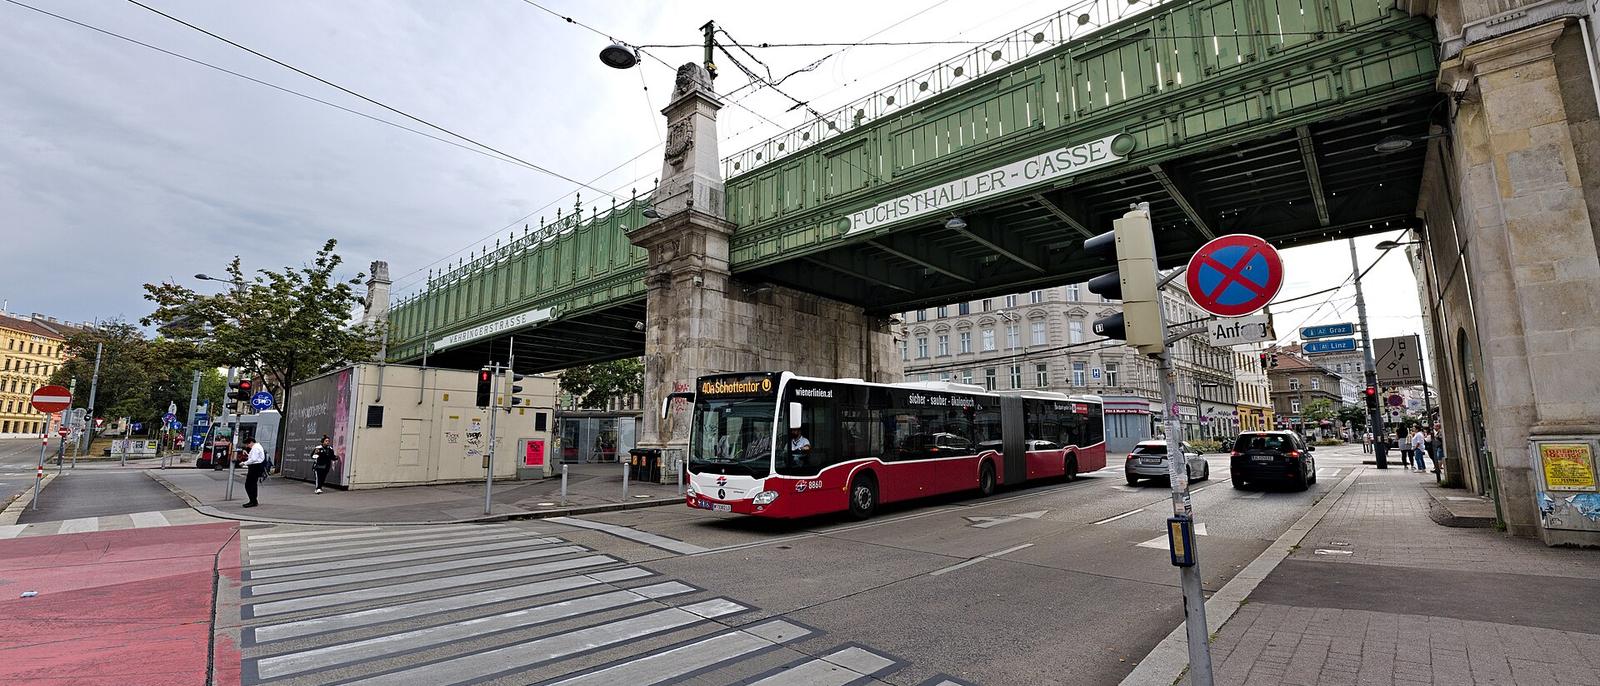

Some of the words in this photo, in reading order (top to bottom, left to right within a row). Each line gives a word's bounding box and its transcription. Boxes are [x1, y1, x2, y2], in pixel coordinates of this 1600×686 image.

[853, 171, 1006, 229] FUCHSTHALLER
[1023, 141, 1108, 180] GASSE
[1216, 321, 1267, 339] Anfg
[715, 381, 759, 394] Schottentor
[795, 387, 833, 398] wienerlinien.at
[909, 393, 926, 405] sicher
[930, 395, 947, 406] sauber
[808, 480, 823, 489] 8860
